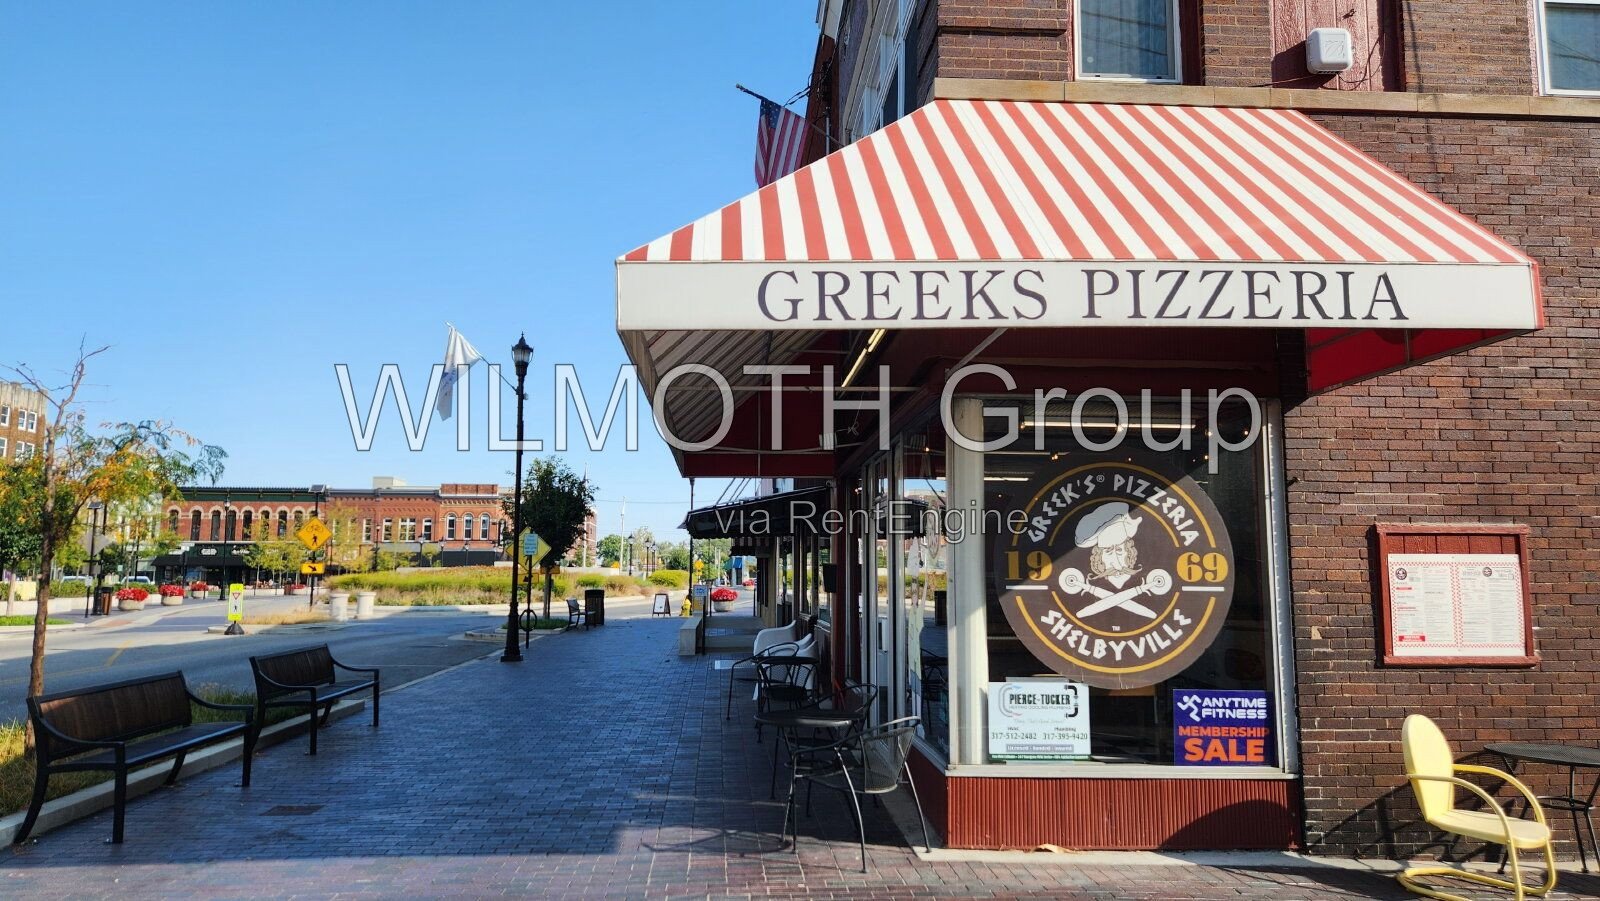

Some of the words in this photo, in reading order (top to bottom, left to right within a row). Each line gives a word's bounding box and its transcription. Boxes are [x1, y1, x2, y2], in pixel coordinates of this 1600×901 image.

[757, 269, 1047, 322] GREEKS
[1080, 269, 1409, 320] PIZZERIA
[1113, 474, 1199, 546] PIZZERIA
[1005, 551, 1053, 581] 19
[1176, 552, 1228, 582] 69
[1040, 609, 1192, 661] SHELBYVILLE
[1009, 694, 1071, 705] PIERCE-TUCKER
[1202, 697, 1267, 708] ANYTIME
[1201, 708, 1267, 719] FITNESS
[1178, 725, 1270, 737] MEMBERSHIP
[1184, 737, 1264, 762] SALE
